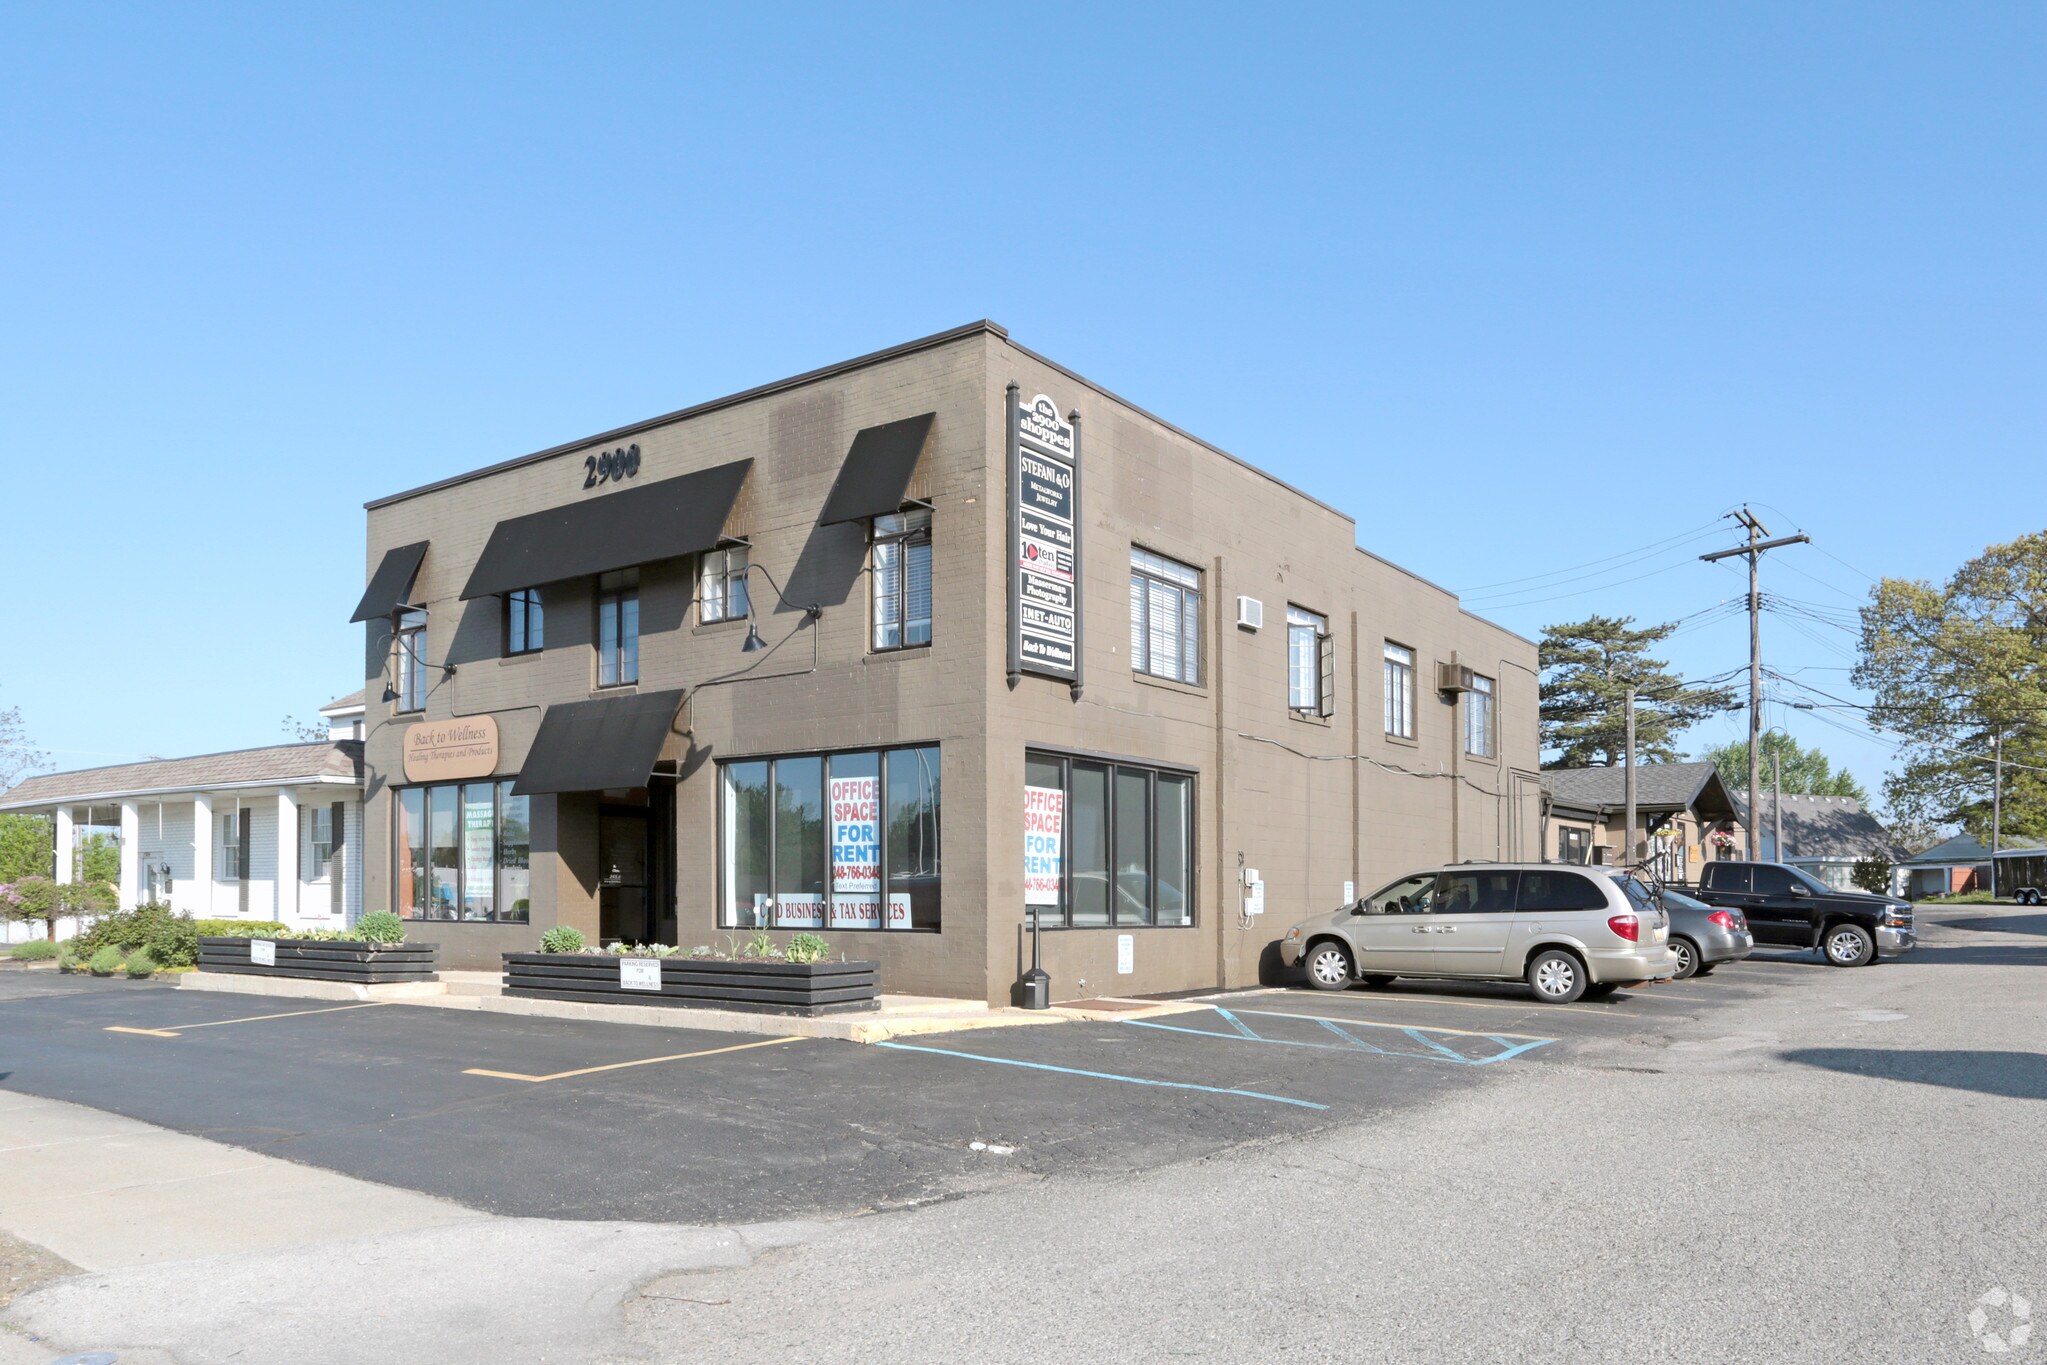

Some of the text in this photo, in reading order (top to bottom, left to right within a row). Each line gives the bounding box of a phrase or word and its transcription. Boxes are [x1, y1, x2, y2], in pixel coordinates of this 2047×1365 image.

[1038, 402, 1053, 417] the
[1031, 411, 1060, 431] 2900
[1020, 417, 1071, 448] shoppes
[582, 443, 641, 490] 2900
[1021, 456, 1056, 484] STEFANI
[1022, 517, 1072, 544] Love Your Hair
[1022, 606, 1072, 629] INET-AUTO
[414, 724, 487, 747] Back to Wellness
[831, 780, 880, 801] OFFICE
[1023, 789, 1064, 813] OFFICE
[467, 808, 494, 819] MASSAG
[834, 801, 878, 822] SPACE
[1023, 811, 1061, 834] SPACE
[837, 824, 874, 843] FOR
[832, 844, 881, 863] RENT
[1026, 835, 1057, 854] FOR
[1024, 855, 1063, 875] RENT
[848, 882, 878, 891] Preferred
[785, 902, 822, 920] BUSINES
[839, 902, 858, 919] TAX
[859, 903, 905, 920] SERVCES
